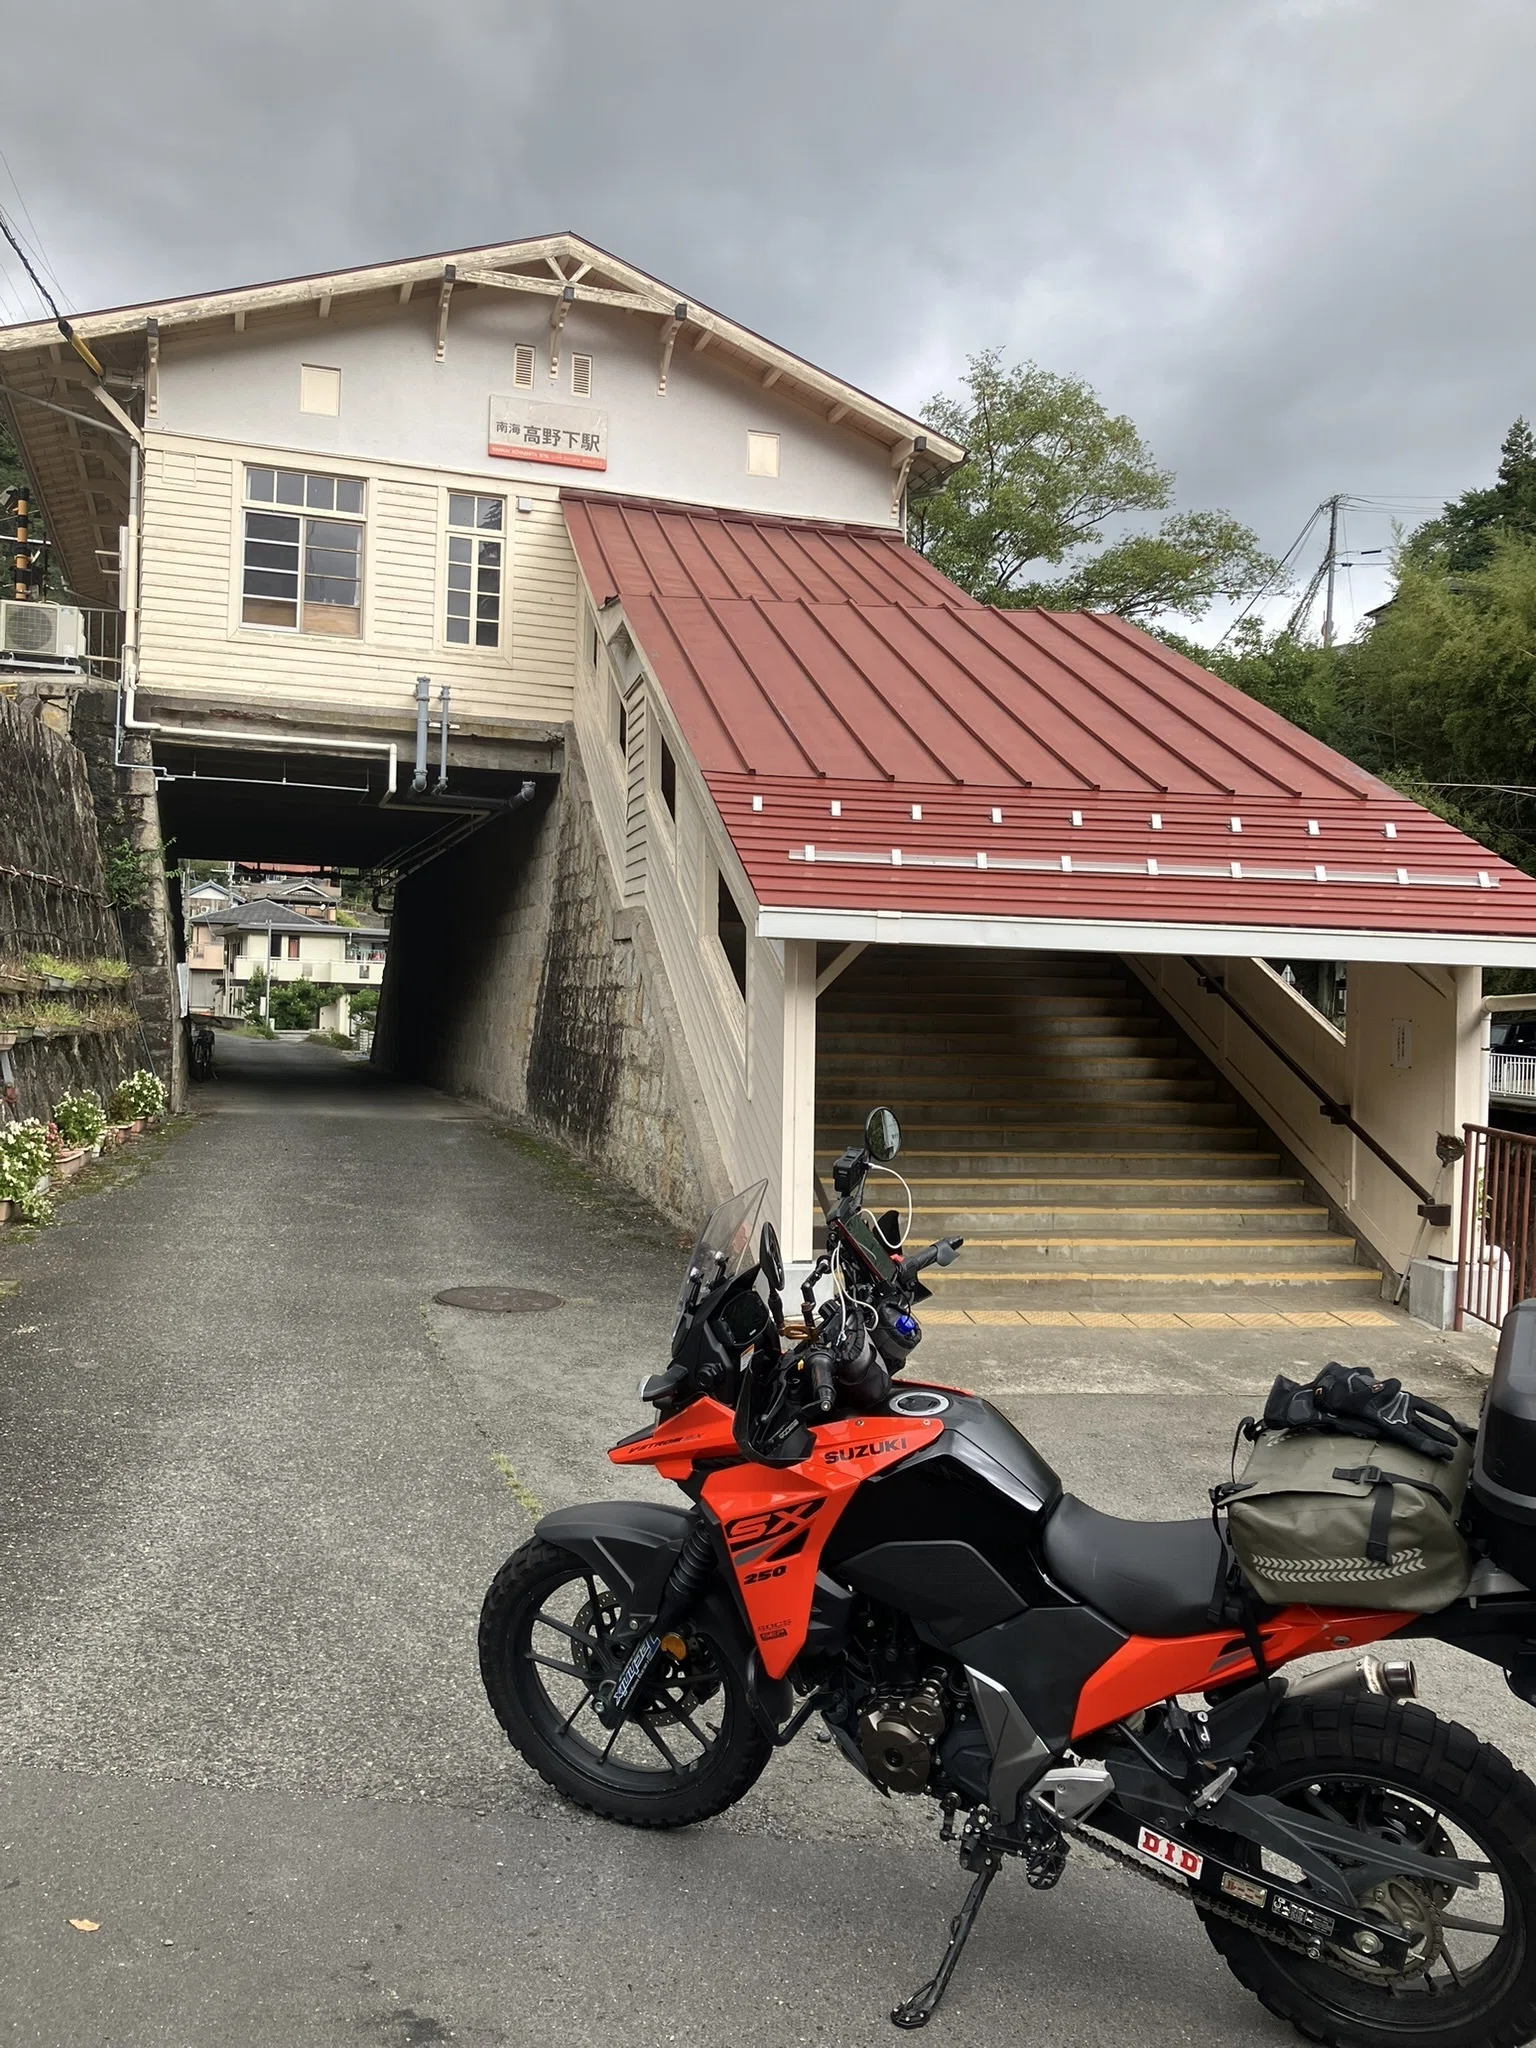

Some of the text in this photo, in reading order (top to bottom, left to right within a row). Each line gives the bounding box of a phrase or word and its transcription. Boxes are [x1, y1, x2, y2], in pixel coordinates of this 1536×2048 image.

[496, 421, 600, 453] 南海 高野下駅
[824, 1437, 907, 1464] SUZUKI
[729, 1502, 814, 1537] SX
[743, 1565, 787, 1585] 250
